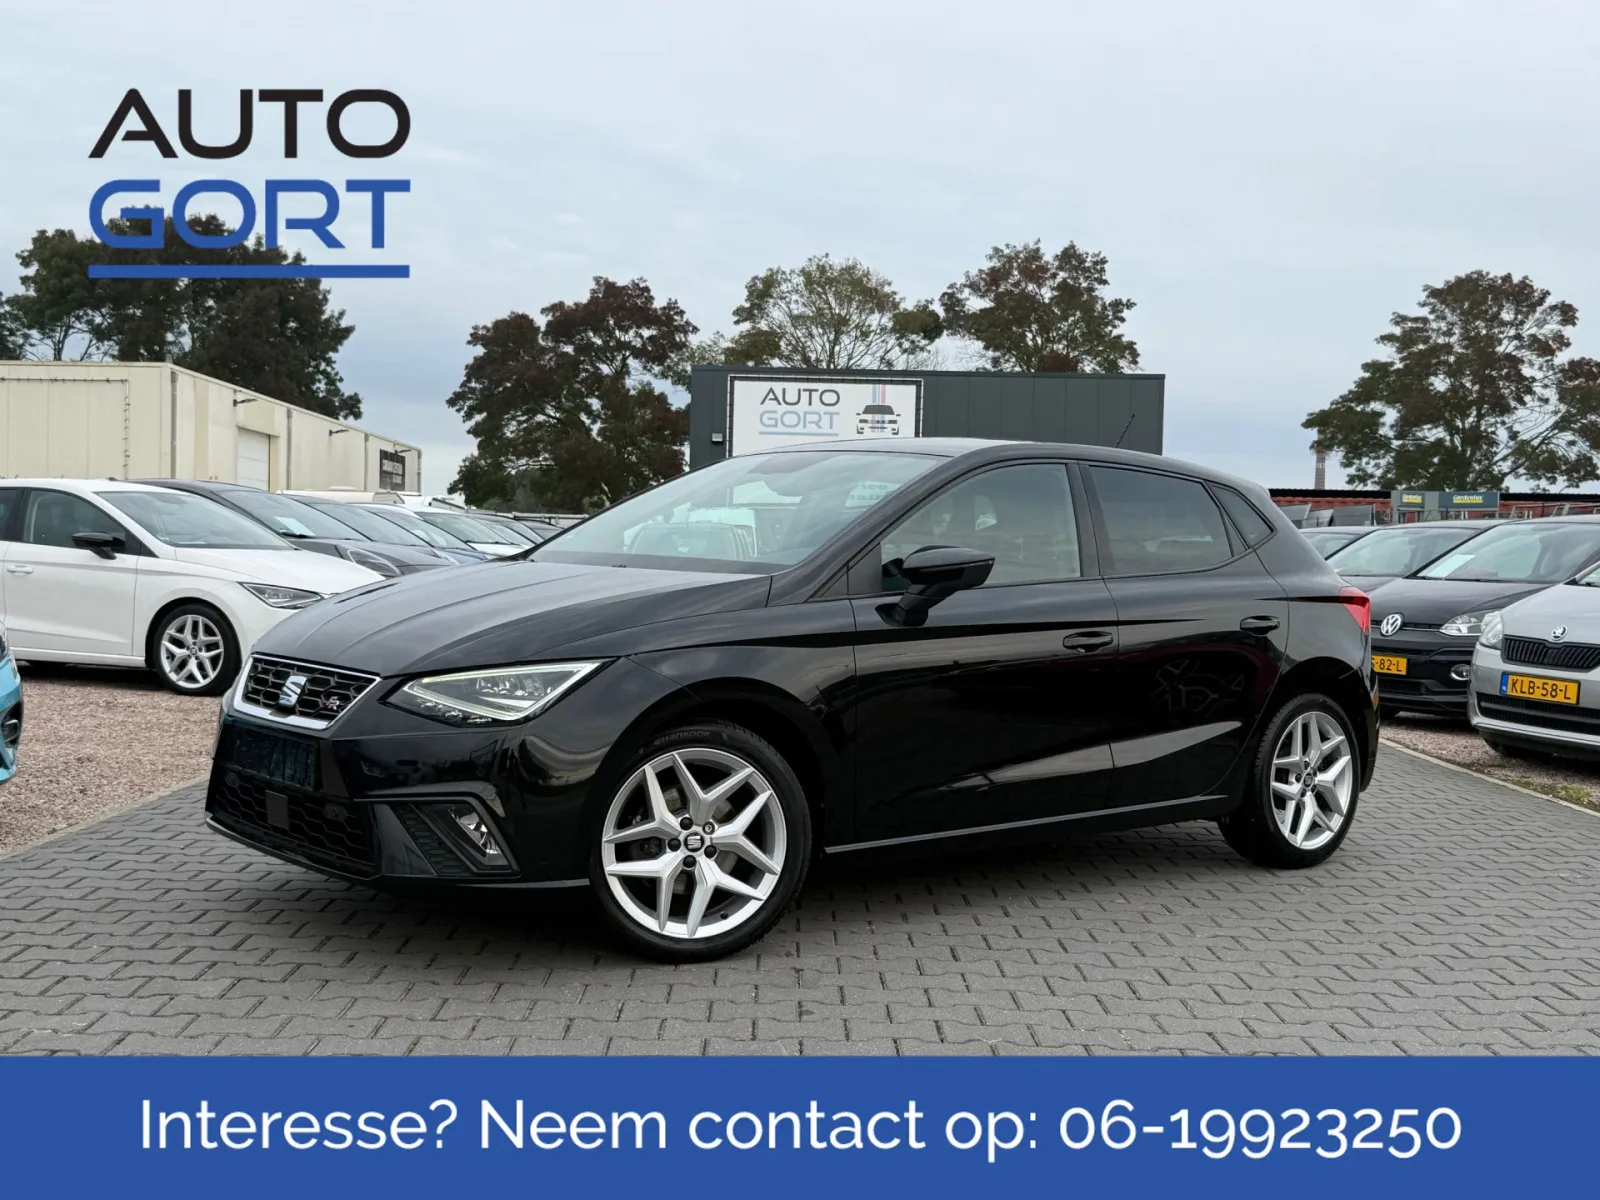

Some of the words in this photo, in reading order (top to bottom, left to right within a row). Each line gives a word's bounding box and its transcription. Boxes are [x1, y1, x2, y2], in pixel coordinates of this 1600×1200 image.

[760, 387, 841, 407] AUTO
[760, 410, 840, 430] GORT
[1511, 678, 1571, 700] KLB-58-L
